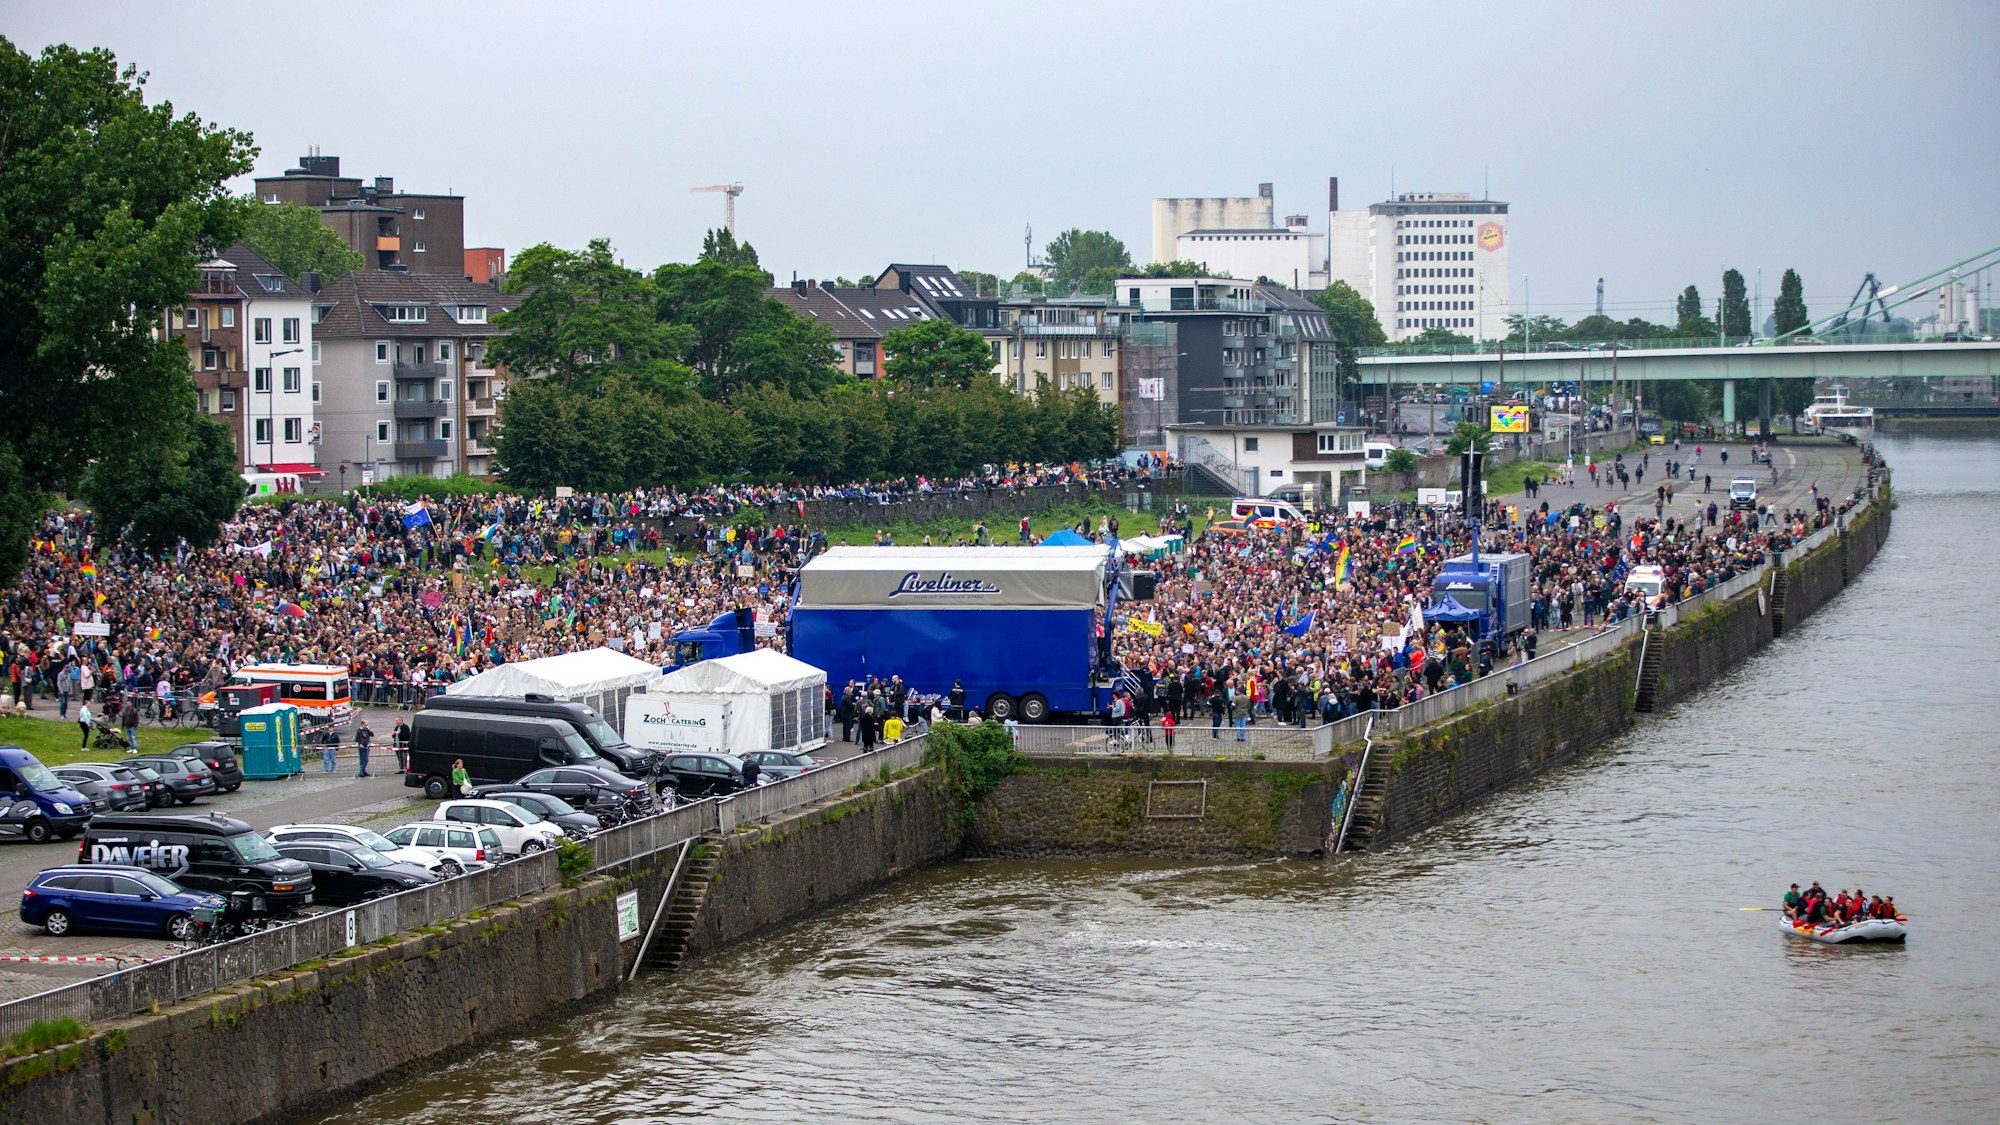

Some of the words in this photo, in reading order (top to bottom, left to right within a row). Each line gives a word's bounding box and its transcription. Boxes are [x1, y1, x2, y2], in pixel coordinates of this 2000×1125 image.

[643, 714, 667, 724] ZOCH
[671, 717, 707, 727] CATERING
[349, 917, 354, 940] 8
